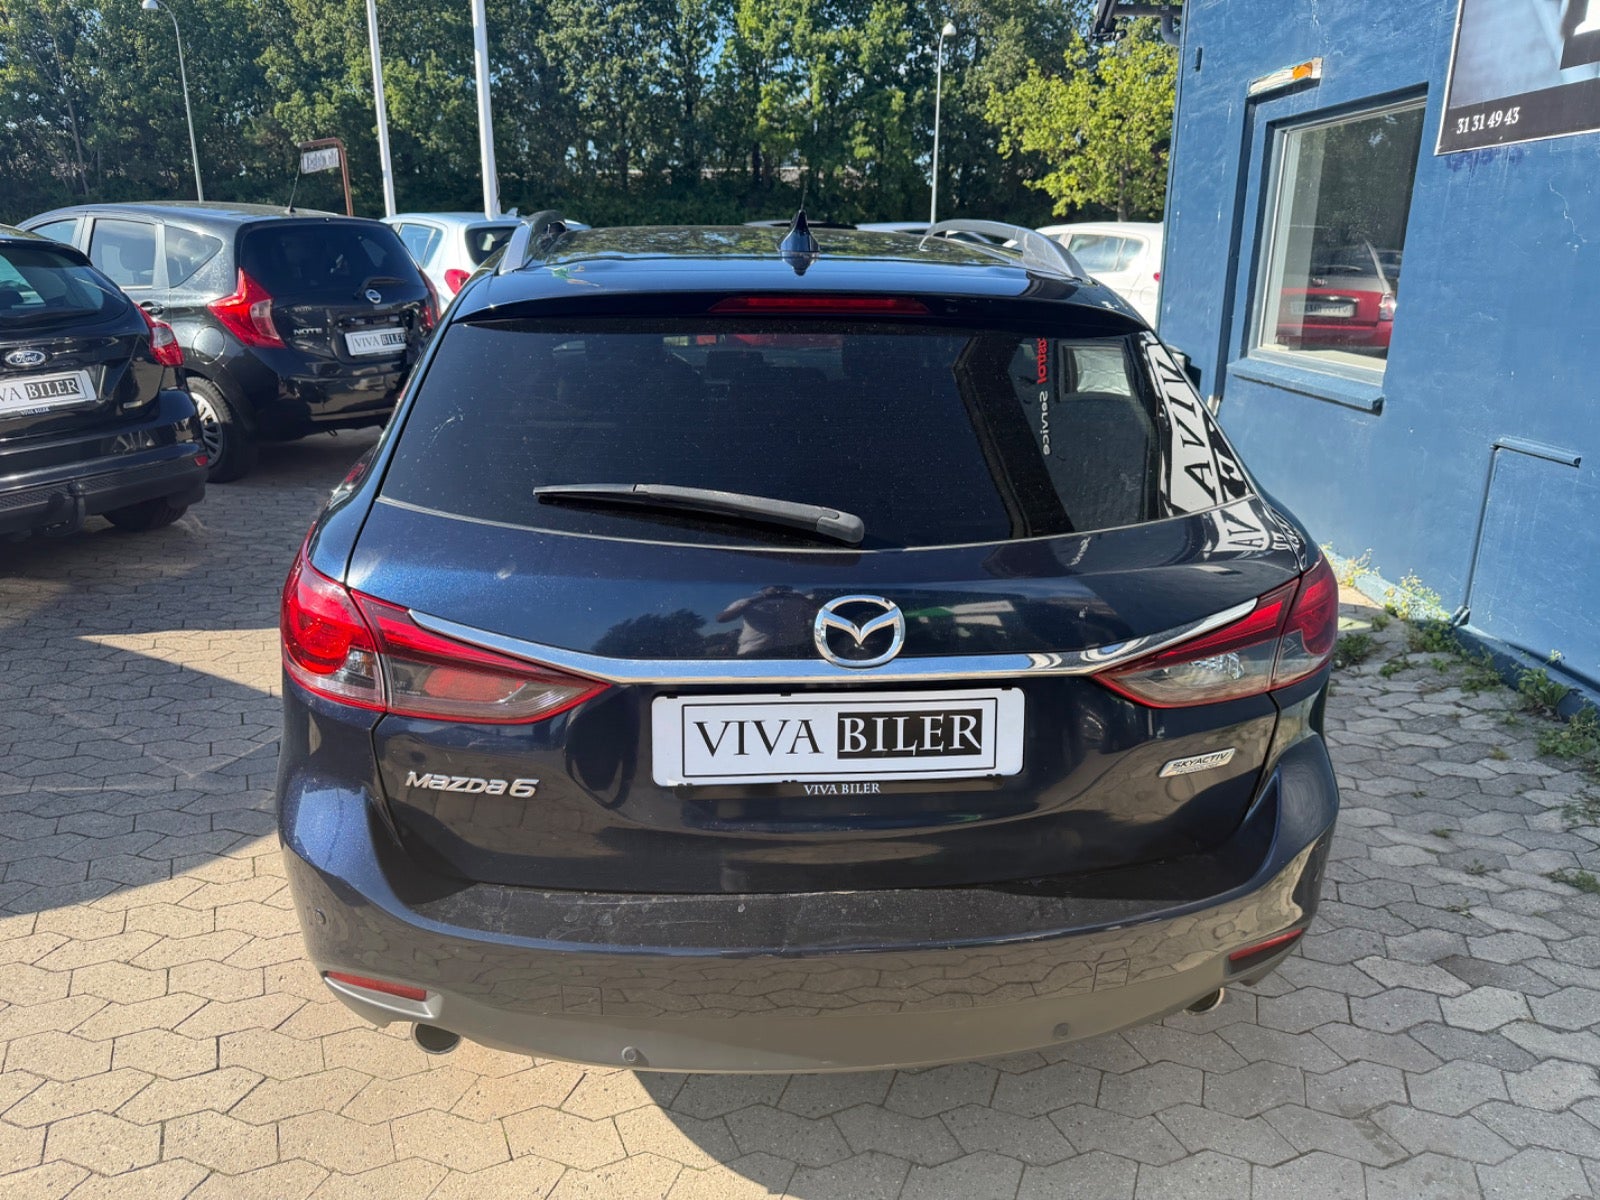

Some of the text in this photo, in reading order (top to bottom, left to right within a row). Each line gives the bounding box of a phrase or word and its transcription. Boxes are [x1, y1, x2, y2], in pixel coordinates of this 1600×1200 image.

[1456, 106, 1520, 134] 31 31 49 43
[294, 328, 322, 336] NOTE
[354, 336, 380, 348] VIVA
[16, 352, 37, 362] Ford
[26, 380, 80, 399] BILER
[693, 713, 982, 757] VIVA BILER
[1173, 752, 1229, 767] SKYACTIV
[803, 783, 881, 795] VIVA BILER
